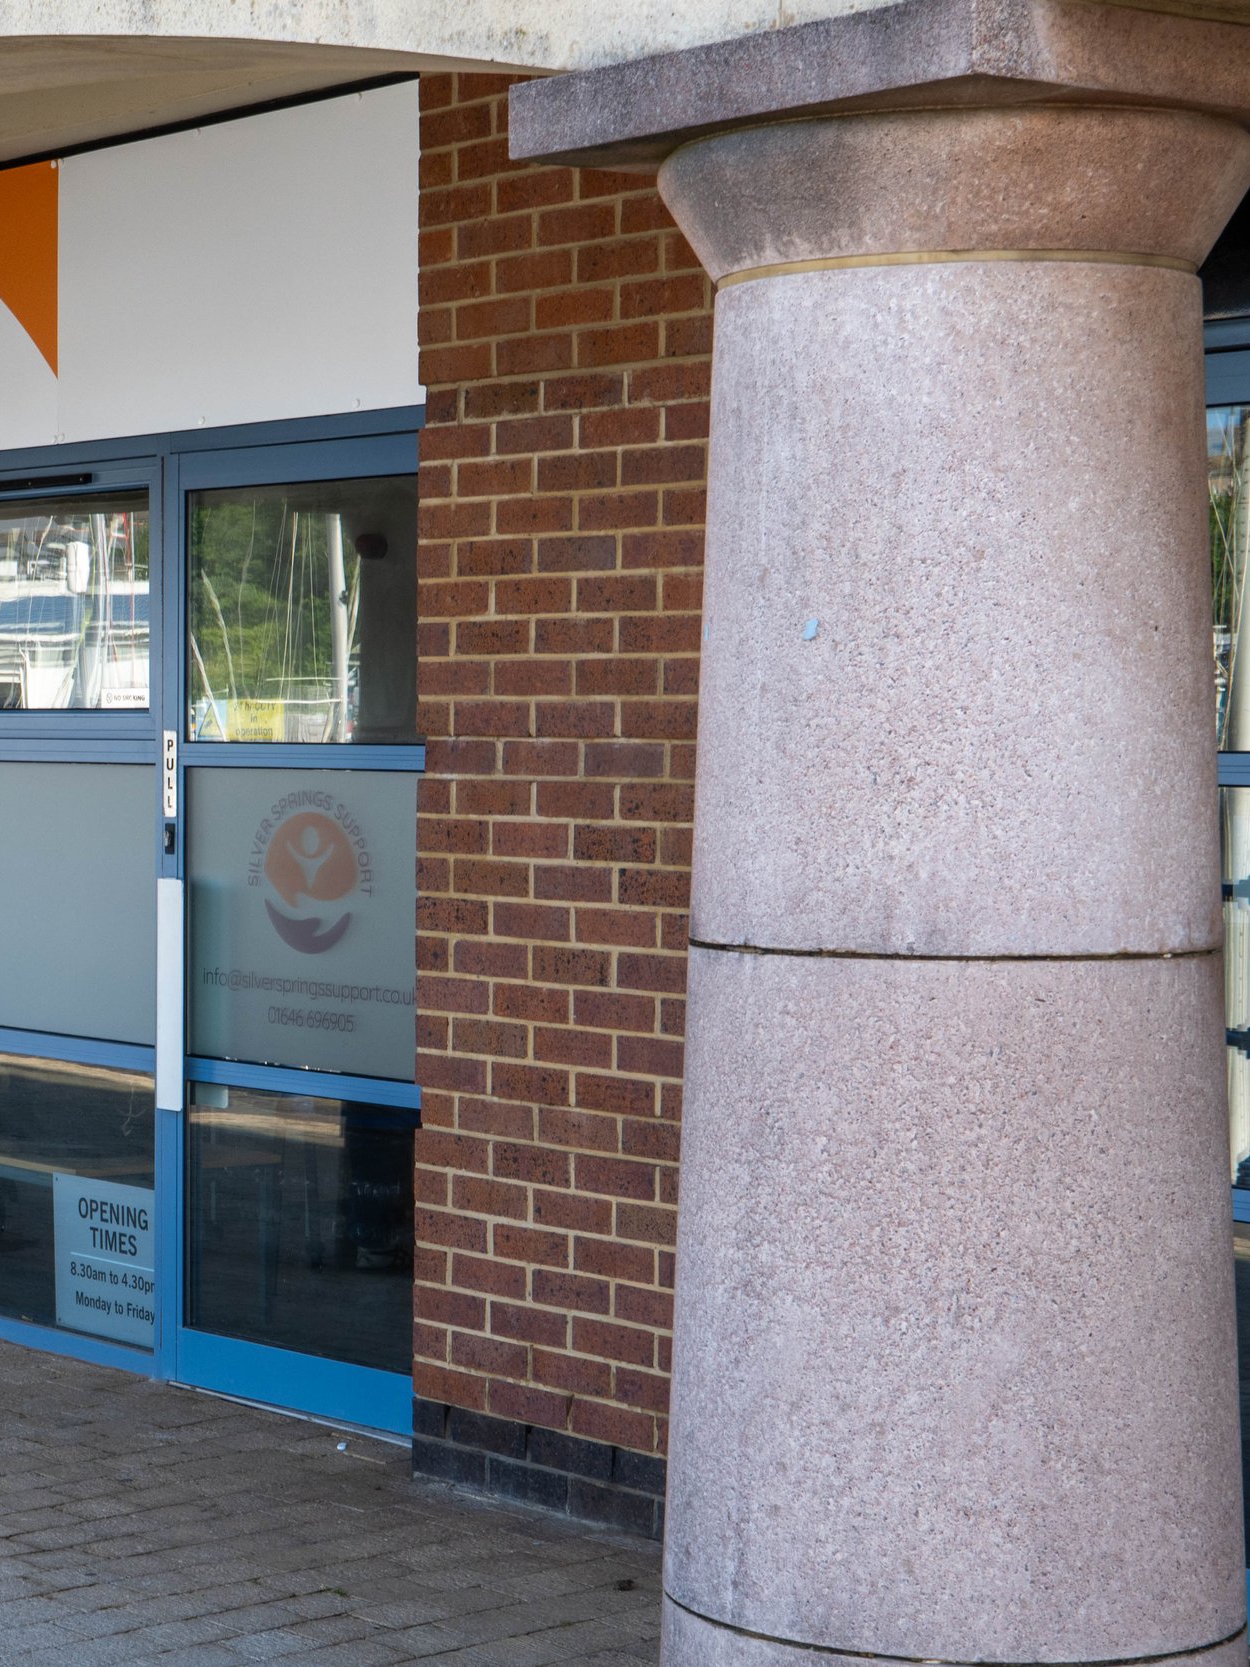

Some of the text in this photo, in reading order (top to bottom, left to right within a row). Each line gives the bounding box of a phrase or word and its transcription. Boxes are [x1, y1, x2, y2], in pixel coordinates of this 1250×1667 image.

[235, 726, 274, 737] operation
[166, 739, 175, 808] PULL
[247, 790, 374, 898] SILVER SPRINGS SUPPORT
[267, 1006, 354, 1033] 01646 696905
[78, 1197, 149, 1232] OPENING
[89, 1226, 138, 1256] TIMES
[70, 1261, 107, 1282] 8.30am
[109, 1271, 119, 1285] to
[75, 1291, 155, 1326] Monday to Friday
